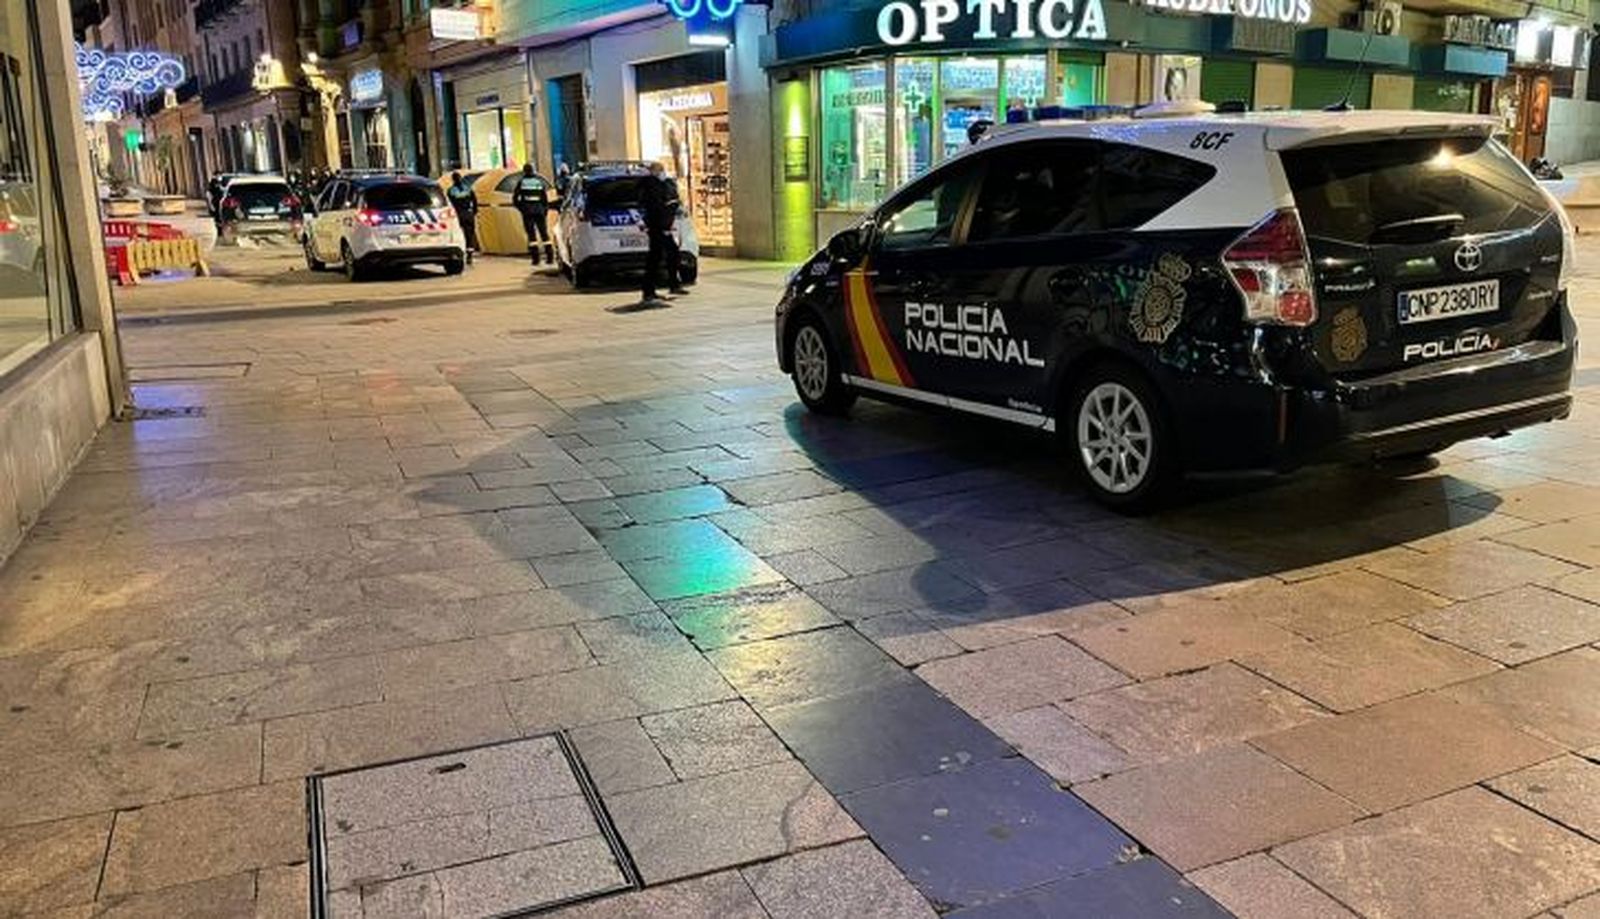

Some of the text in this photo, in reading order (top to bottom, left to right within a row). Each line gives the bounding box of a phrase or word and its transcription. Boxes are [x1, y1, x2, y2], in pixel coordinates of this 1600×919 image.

[1146, 0, 1312, 24] DIFONOS
[1189, 131, 1234, 150] 8CF
[904, 301, 1008, 335] POLICÍA
[906, 327, 1045, 367] NACIONAL
